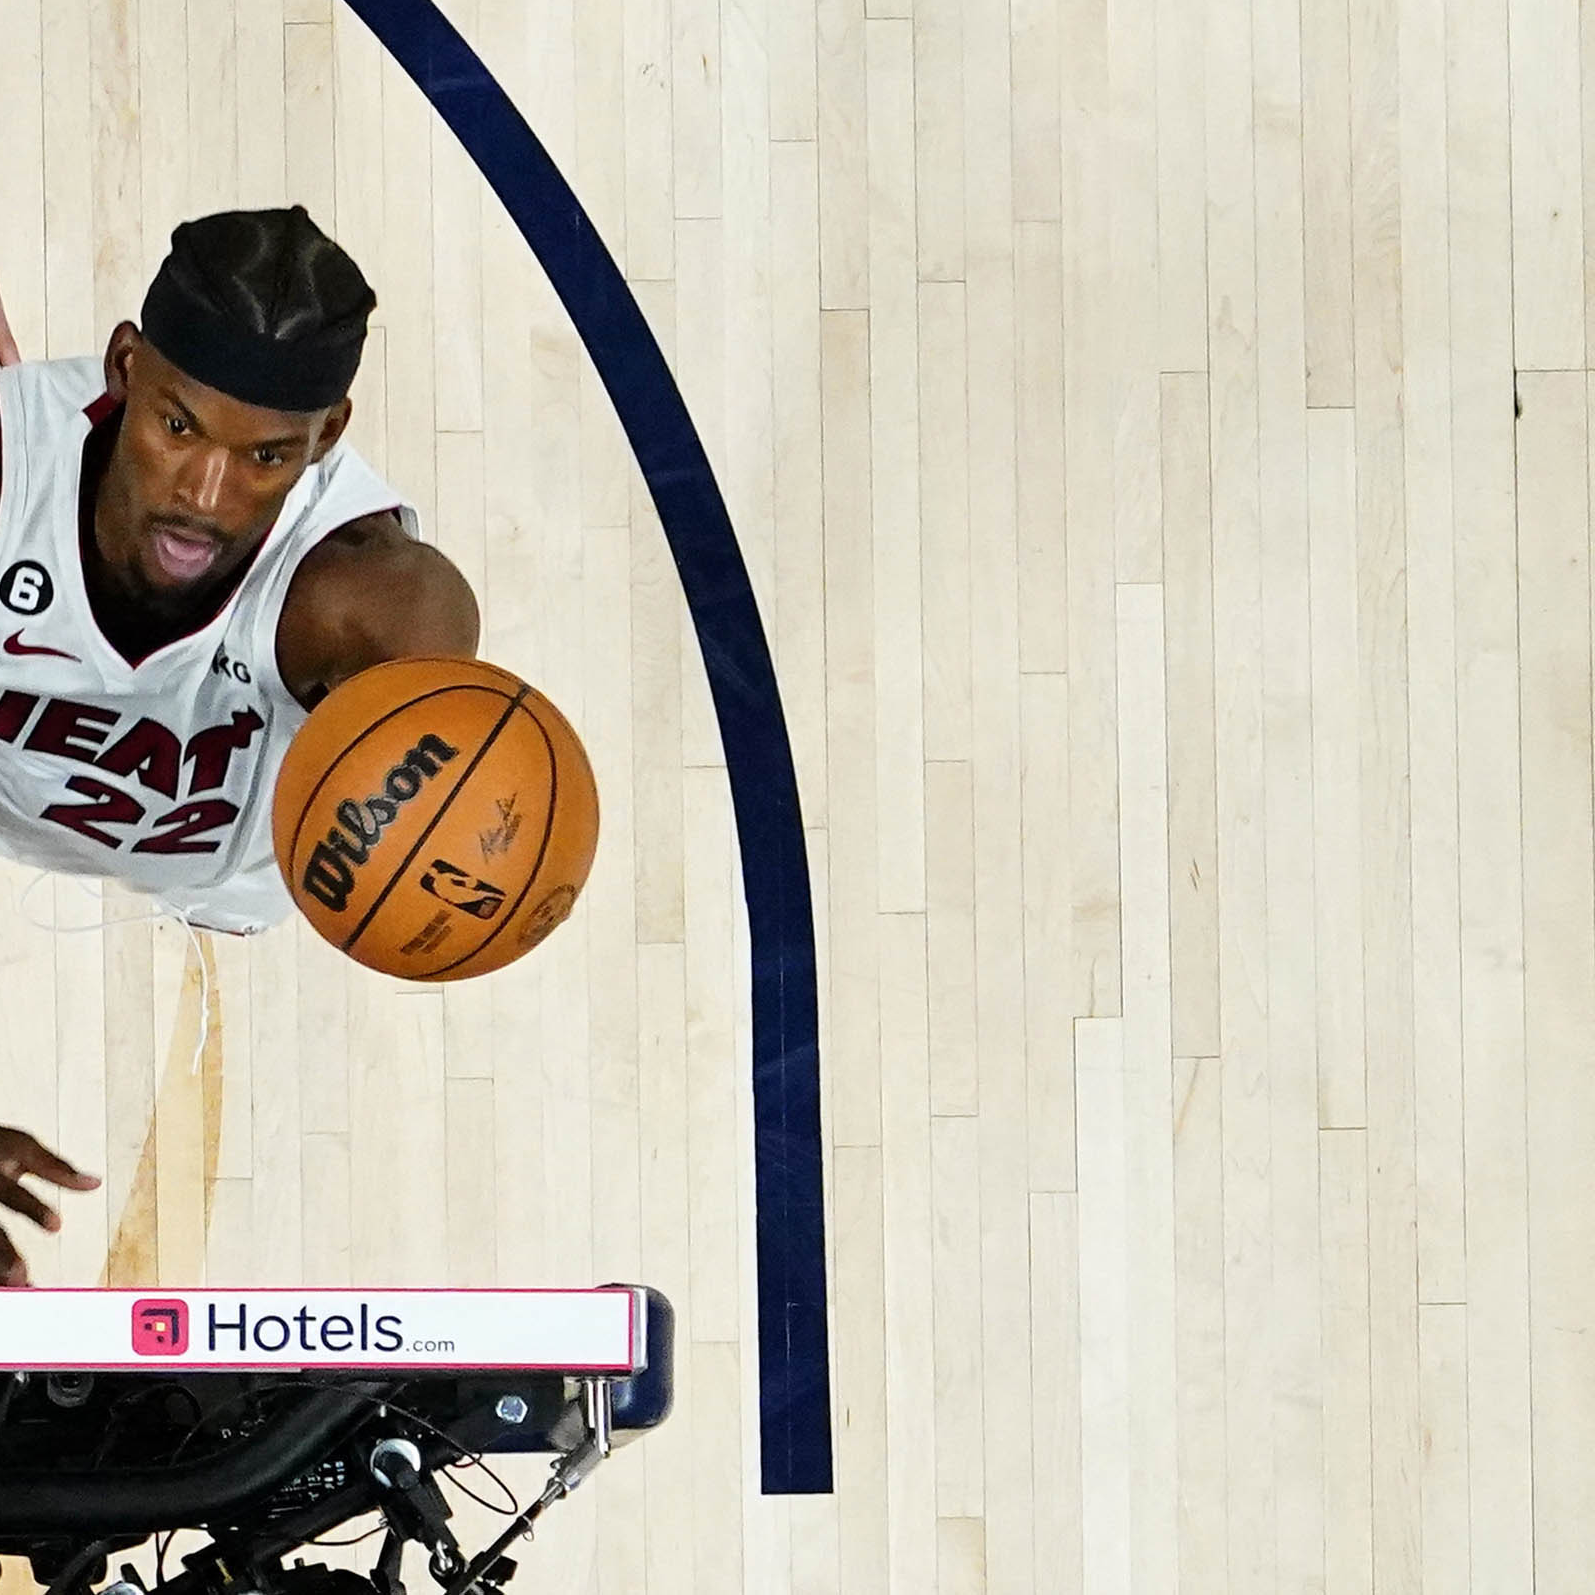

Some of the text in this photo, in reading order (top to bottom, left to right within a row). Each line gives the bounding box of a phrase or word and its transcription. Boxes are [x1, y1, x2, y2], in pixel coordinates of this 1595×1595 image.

[9, 566, 44, 611] 6
[39, 774, 241, 854] 22
[302, 733, 460, 913] Wilson
